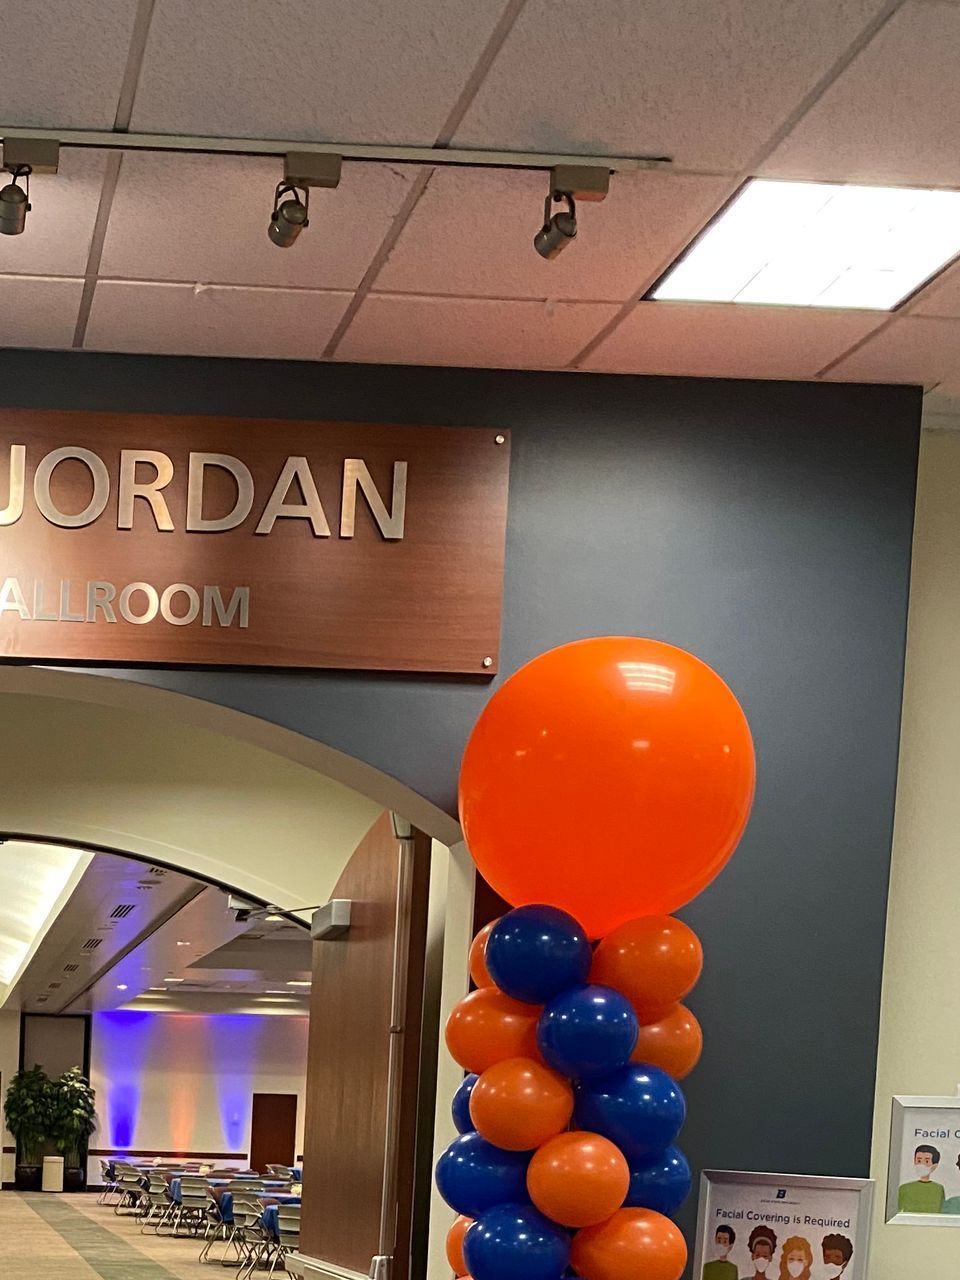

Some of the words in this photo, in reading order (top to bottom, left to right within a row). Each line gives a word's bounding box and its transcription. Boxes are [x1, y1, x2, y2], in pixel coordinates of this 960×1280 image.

[914, 1128, 950, 1138] Facial
[716, 1208, 744, 1219] Facial
[746, 1210, 790, 1225] Covering
[793, 1215, 801, 1224] is
[804, 1215, 851, 1228] Required
